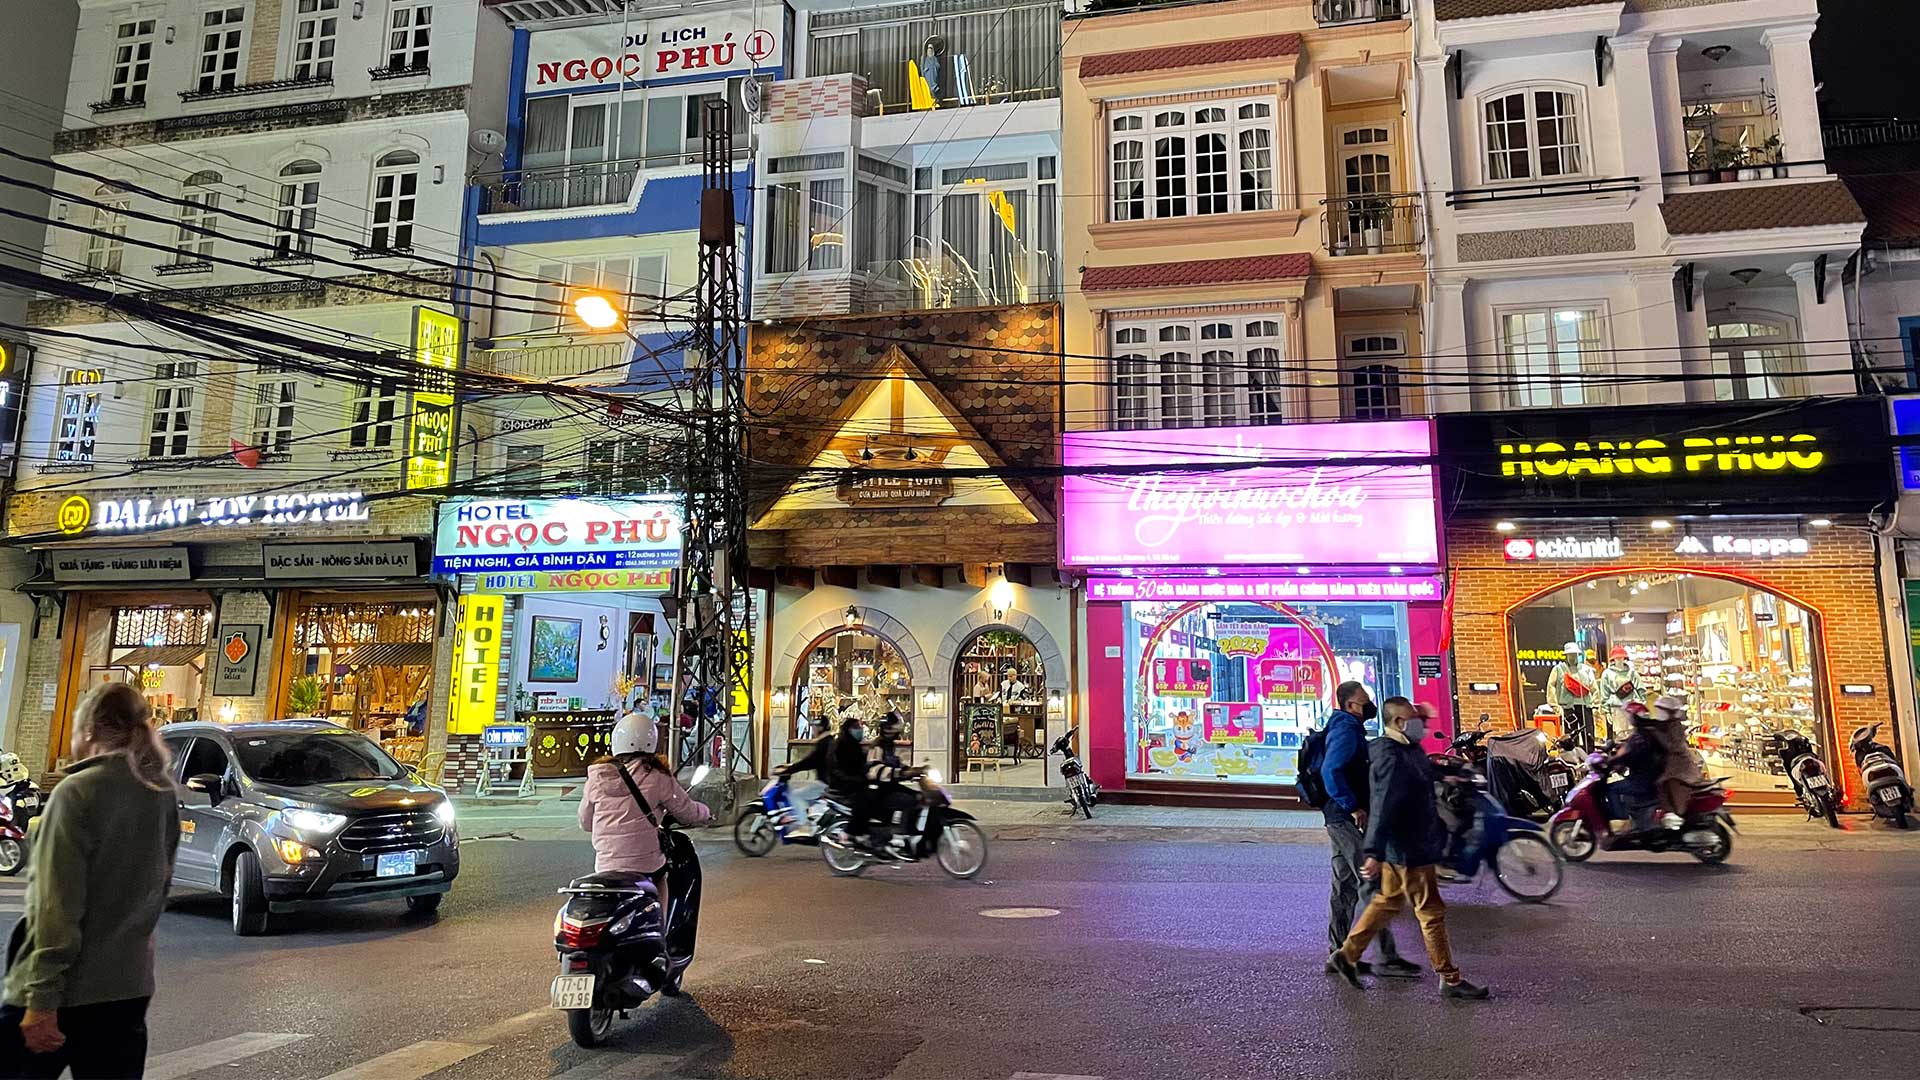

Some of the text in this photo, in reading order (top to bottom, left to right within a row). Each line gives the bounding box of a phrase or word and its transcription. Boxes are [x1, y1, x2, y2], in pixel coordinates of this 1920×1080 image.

[622, 27, 706, 48] DU LỊCH
[536, 53, 640, 85] NGỌC
[656, 32, 736, 73] PHÚ
[416, 407, 449, 434] NGỌC
[418, 431, 443, 455] PHÚ
[1500, 438, 1672, 476] HOANG
[95, 499, 195, 529] DALAT
[262, 492, 369, 524] HOTEL
[457, 504, 533, 521] HOTEL
[456, 511, 670, 551] NGỌC PHÚ
[628, 551, 636, 559] 12
[1712, 536, 1808, 556] Kappa
[270, 555, 292, 569] ĐẶC
[294, 554, 314, 567] SẢN
[322, 555, 352, 567] NÔNG
[353, 553, 374, 566] SẢN
[375, 555, 389, 566] ĐÀ
[391, 555, 409, 568] LẠT
[444, 554, 606, 569] TIỆN NGHI, GIÁ BÌNH DÂN
[486, 574, 538, 589] HOTEL
[548, 572, 619, 590] NGỌC
[1136, 581, 1157, 599] 50
[470, 606, 494, 703] HOTEL
[1218, 635, 1267, 654] 2023
[450, 604, 465, 722] HOTEL
